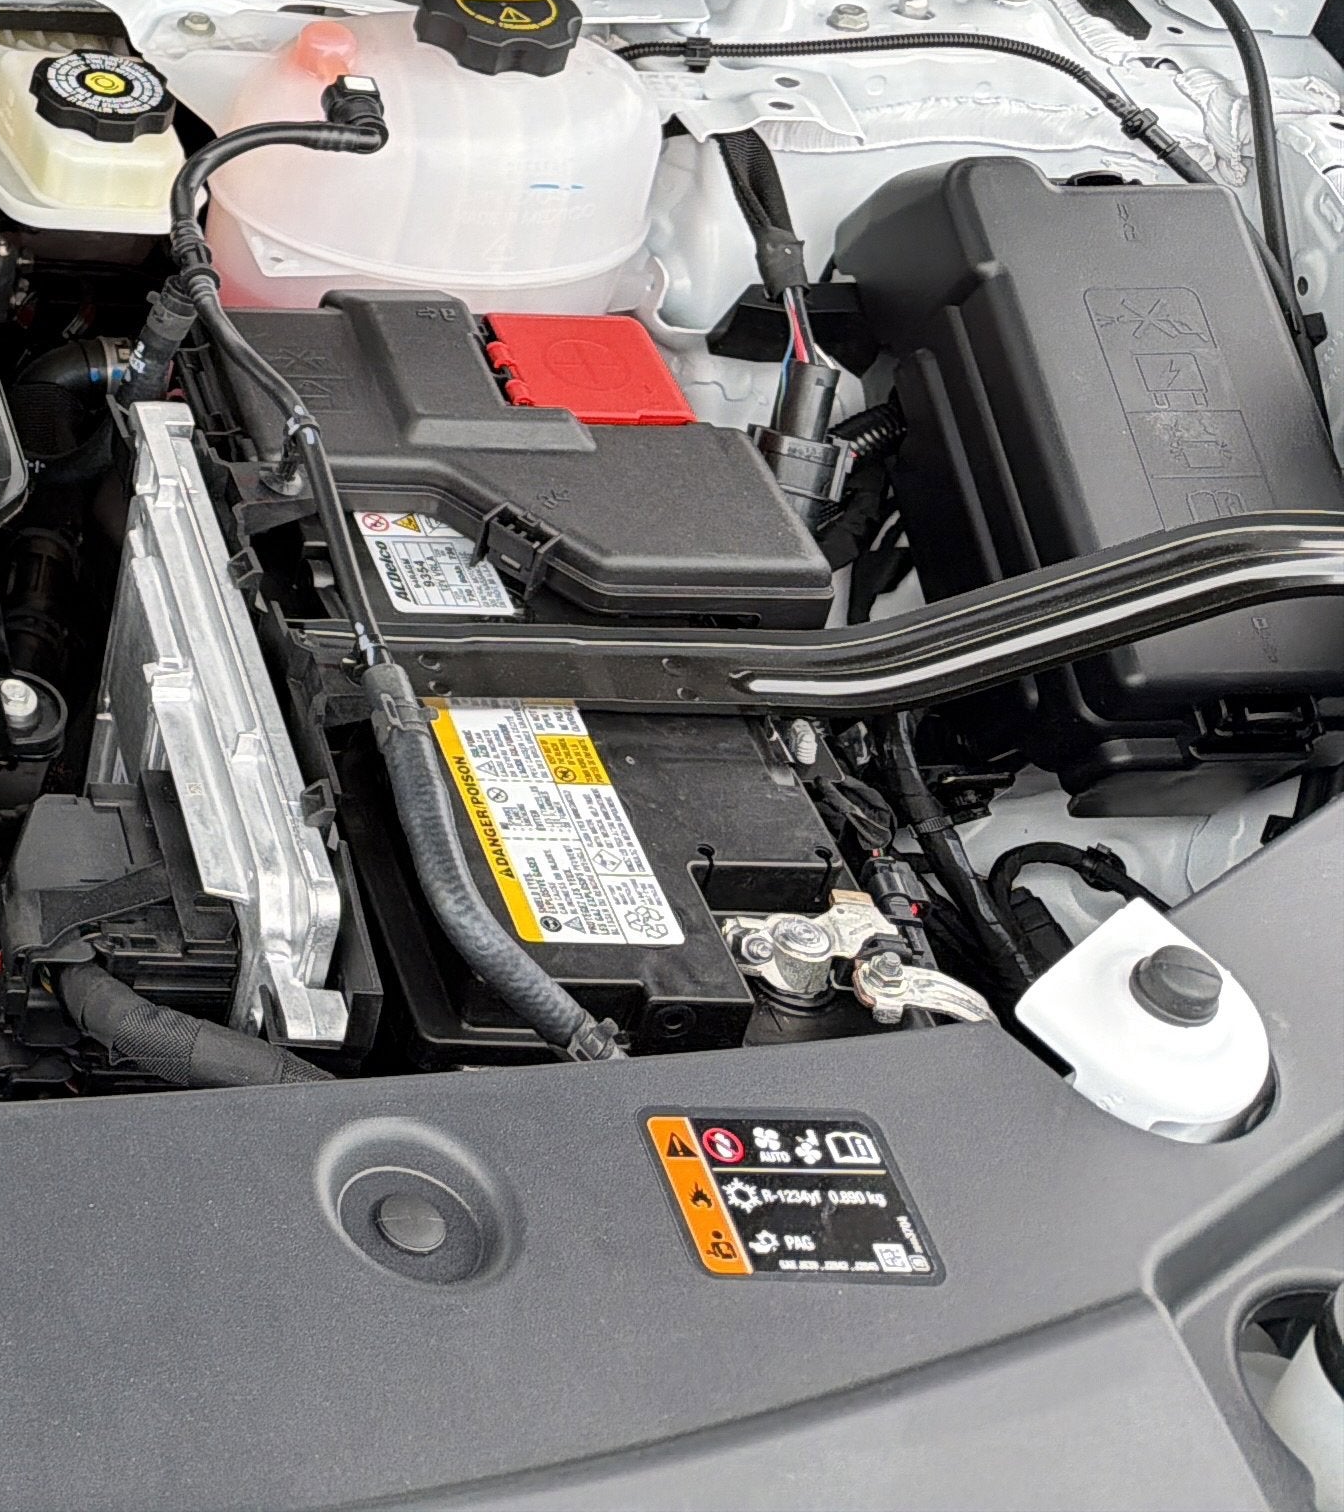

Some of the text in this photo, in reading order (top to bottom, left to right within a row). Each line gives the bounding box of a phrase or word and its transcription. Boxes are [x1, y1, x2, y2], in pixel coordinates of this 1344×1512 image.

[375, 540, 411, 601] ACDelco
[412, 560, 435, 586] 9354
[452, 756, 509, 865] DANGER/POISON
[759, 1150, 791, 1164] AUTO
[760, 1188, 823, 1207] R-1234yf
[865, 1190, 888, 1208] kg
[783, 1234, 817, 1252] PAG
